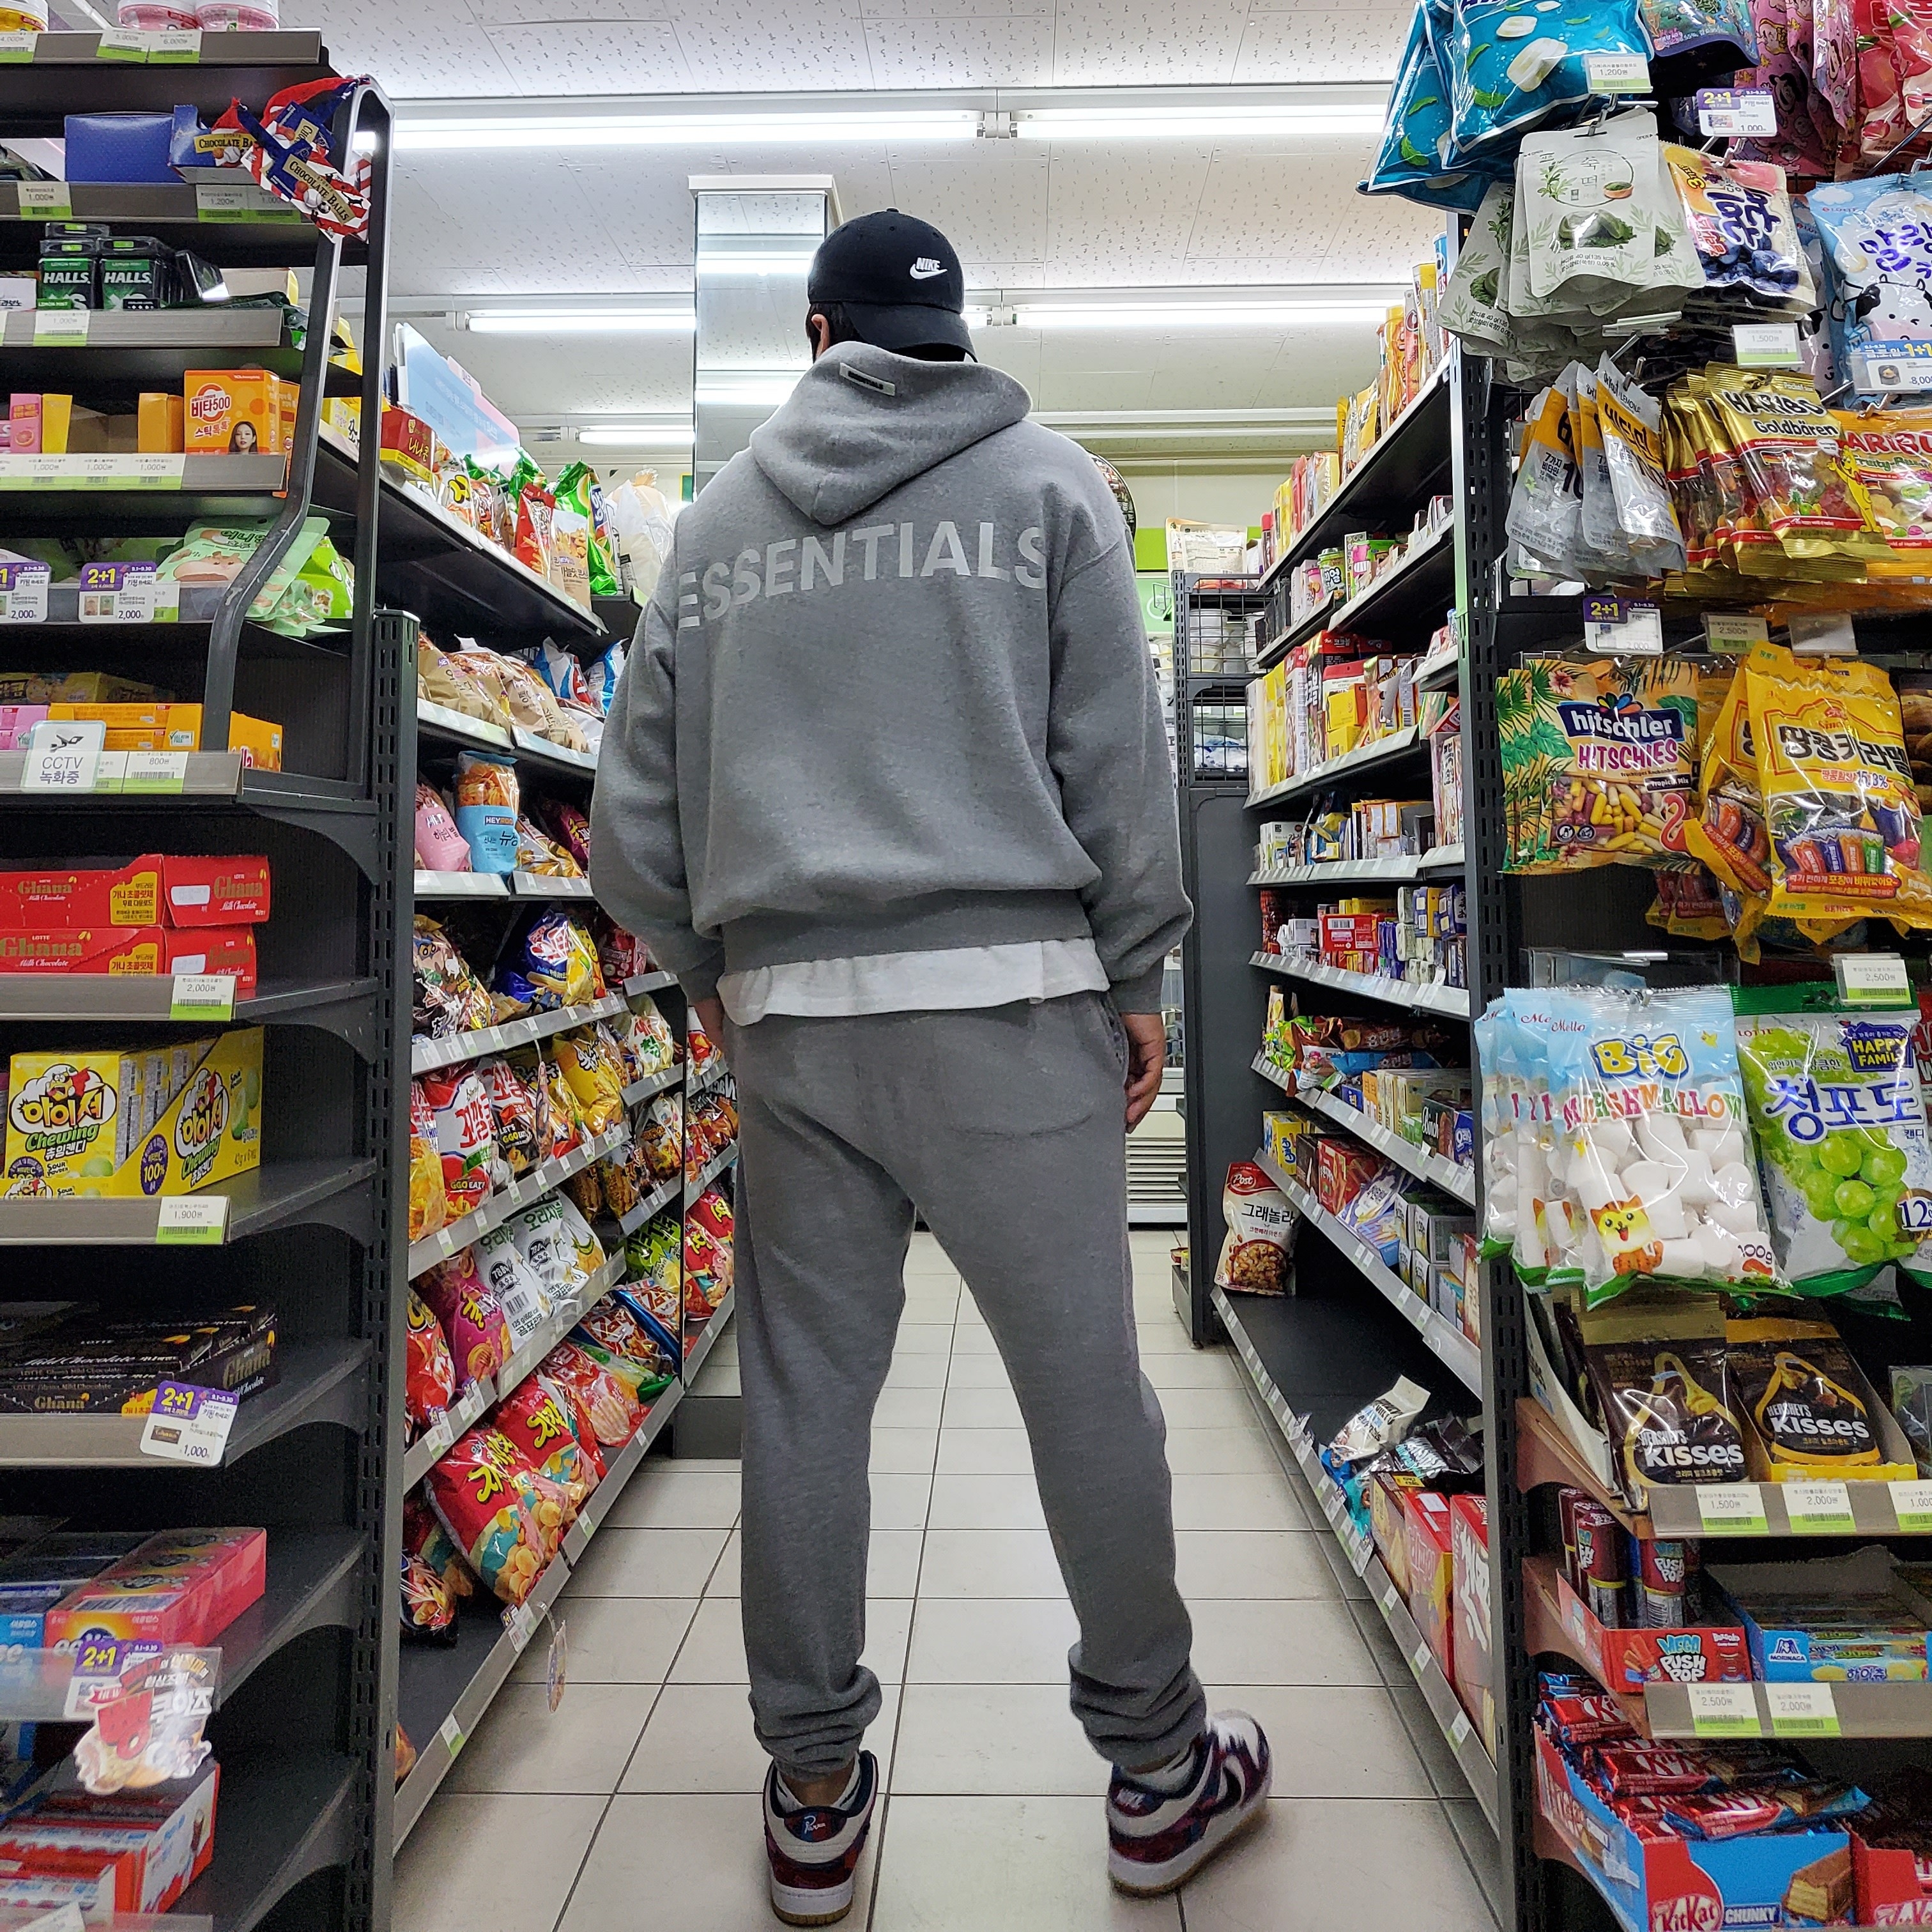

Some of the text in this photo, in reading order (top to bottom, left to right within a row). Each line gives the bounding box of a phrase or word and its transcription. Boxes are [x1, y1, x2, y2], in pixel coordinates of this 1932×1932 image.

[1599, 68, 1629, 76] 1,200원
[1703, 91, 1732, 105] 2+1
[199, 138, 240, 148] CHOCOLATE
[289, 160, 349, 221] CHOCOLATE BALLS
[916, 256, 941, 271] NIKE
[1751, 334, 1780, 342] 1,500원
[191, 396, 231, 418] 비타500
[1724, 389, 1827, 418] HARIBO
[1754, 418, 1841, 440] Goldbären
[1545, 452, 1563, 468] 7가지
[1541, 461, 1560, 477] 비타민
[88, 568, 116, 585] 2+1
[677, 520, 1048, 631] ESSENTIALS
[1590, 601, 1619, 617] 2+1
[1572, 710, 1674, 737] hitschler
[1577, 737, 1679, 773] HITSCHIES
[1777, 724, 1913, 780] 땅콩카라멜
[42, 756, 84, 769] CCTV
[149, 757, 170, 766] 800원
[39, 770, 80, 785] 녹화중
[17, 879, 73, 895] Ghana
[1828, 873, 1853, 885] 포장이
[213, 876, 264, 899] Ghana
[0, 937, 83, 957] Ghana
[34, 958, 69, 968] Chocolate
[1865, 972, 1896, 983] 2,500원
[1551, 1020, 1586, 1032] Mello
[1738, 1028, 1774, 1037] LOTTE
[1851, 1038, 1907, 1054] HAPPY
[1593, 1033, 1689, 1080] BIG
[18, 1085, 104, 1128] 아이셔
[1565, 1084, 1743, 1133] MARSHMALLOW
[1763, 1077, 1923, 1142] 청포도
[1422, 1106, 1439, 1138] Binch
[26, 1123, 100, 1153] Chewing
[502, 1131, 519, 1144] GGO
[1455, 1127, 1472, 1148] 오레오
[1904, 1128, 1925, 1140] 캔디
[450, 1180, 468, 1190] GGO
[1232, 1173, 1255, 1187] Post
[174, 1210, 203, 1219] 1,900원
[1241, 1202, 1296, 1227] 그래놀라
[1737, 1244, 1773, 1265] 100g
[34, 1395, 85, 1410] Ghana
[161, 1387, 194, 1410] 2+1
[1766, 1403, 1812, 1418] HERSHEY'S
[1772, 1415, 1870, 1439] KISSES
[1641, 1428, 1687, 1446] HERSHEY'S
[1644, 1443, 1744, 1468] KISSES
[1710, 1499, 1742, 1510] 1,500원
[1806, 1496, 1839, 1506] 2,000원
[1654, 1557, 1685, 1571] PUSH
[1661, 1568, 1685, 1583] POP
[1657, 1634, 1701, 1655] MEGA
[82, 1645, 118, 1667] 2+1
[1660, 1652, 1706, 1671] PUSH
[1670, 1666, 1706, 1682] POP
[1846, 1666, 1887, 1682] 하이츄
[1701, 1696, 1733, 1707] 2,500원
[1779, 1701, 1812, 1712] 2,000원
[1652, 1896, 1722, 1931] KitKat
[1724, 1906, 1776, 1924] CHUNKY
